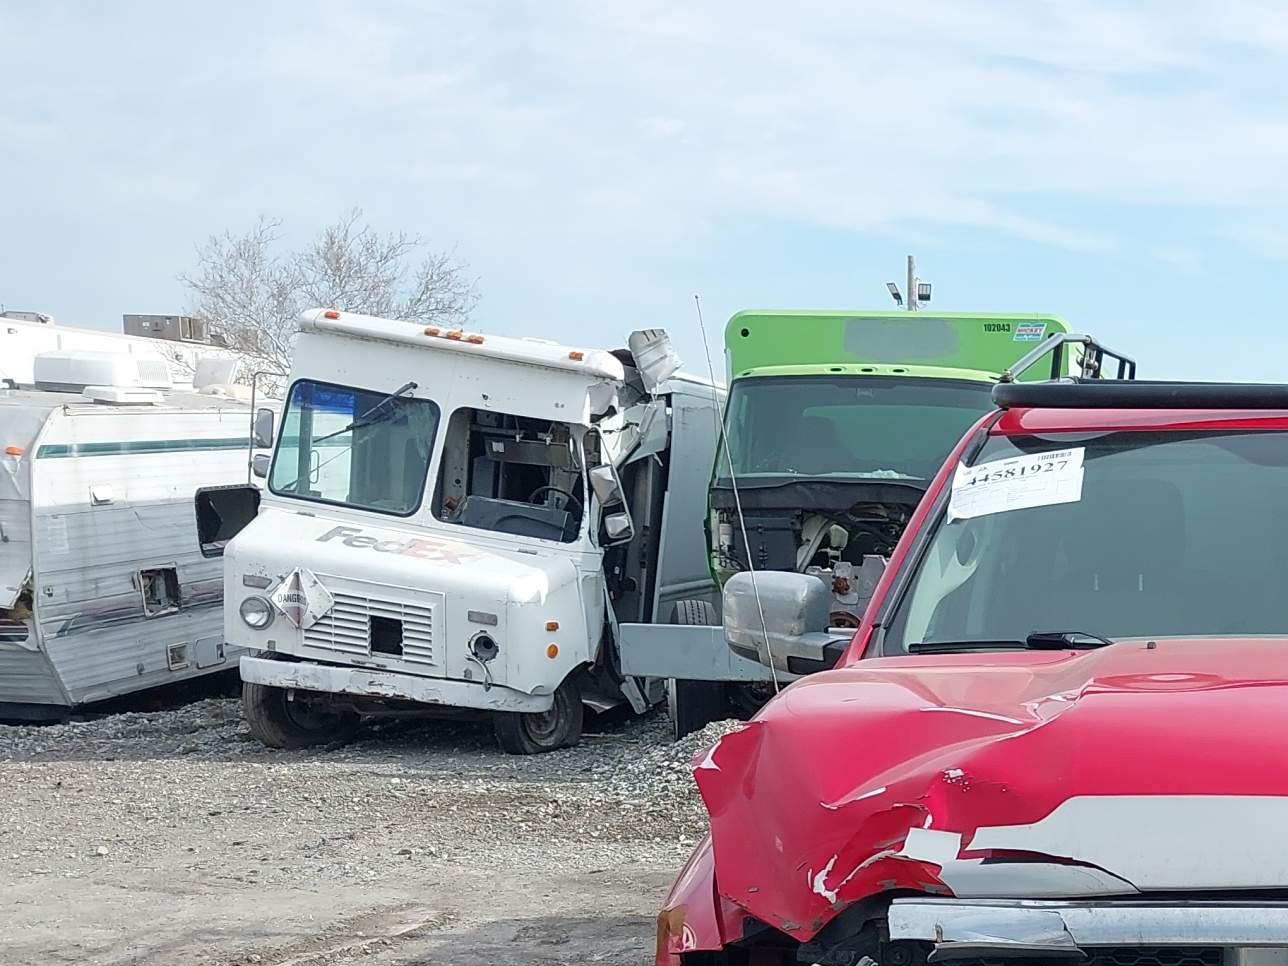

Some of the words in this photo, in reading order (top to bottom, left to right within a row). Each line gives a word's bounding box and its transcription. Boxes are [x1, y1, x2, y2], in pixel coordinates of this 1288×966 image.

[983, 323, 1011, 333] 102043
[967, 460, 1069, 486] 44581927
[315, 525, 478, 565] FedEx
